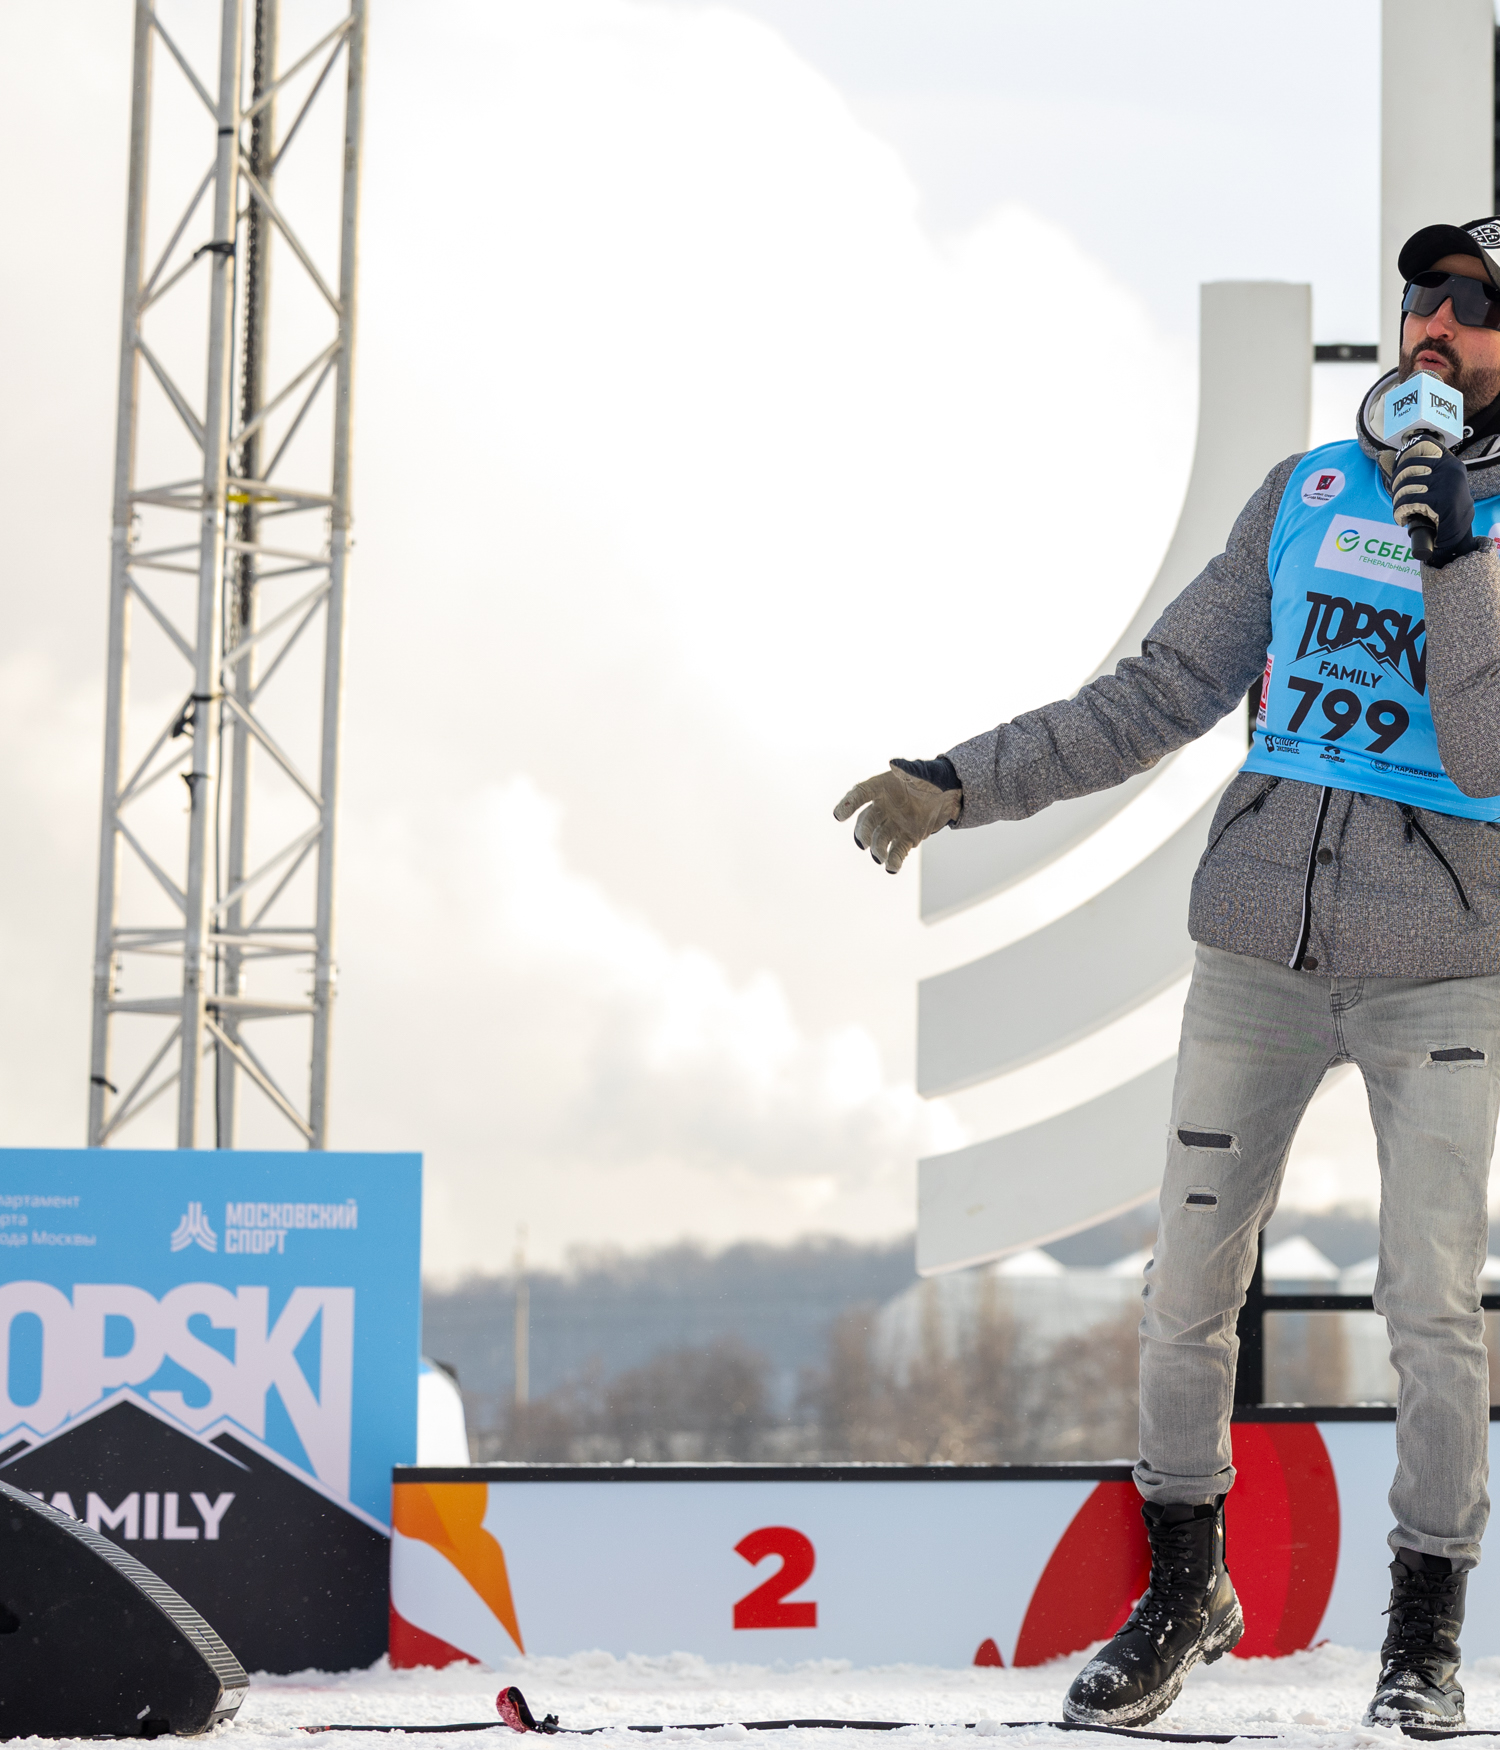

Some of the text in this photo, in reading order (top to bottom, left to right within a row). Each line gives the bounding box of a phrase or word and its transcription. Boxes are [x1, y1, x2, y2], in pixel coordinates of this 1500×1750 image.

[1393, 389, 1419, 417] TOPSKI
[1429, 391, 1458, 420] TOPSKI
[1359, 555, 1411, 574] ГЕНЕРАЛЬНЫЙ
[1318, 660, 1384, 689] FAMILY
[1287, 675, 1410, 755] 799
[0, 1194, 80, 1211] артамент
[225, 1198, 358, 1230] МОСКОВСКИЙ
[31, 1229, 97, 1247] Москвы
[225, 1228, 288, 1254] СПОРТ
[733, 1526, 818, 1629] 2
